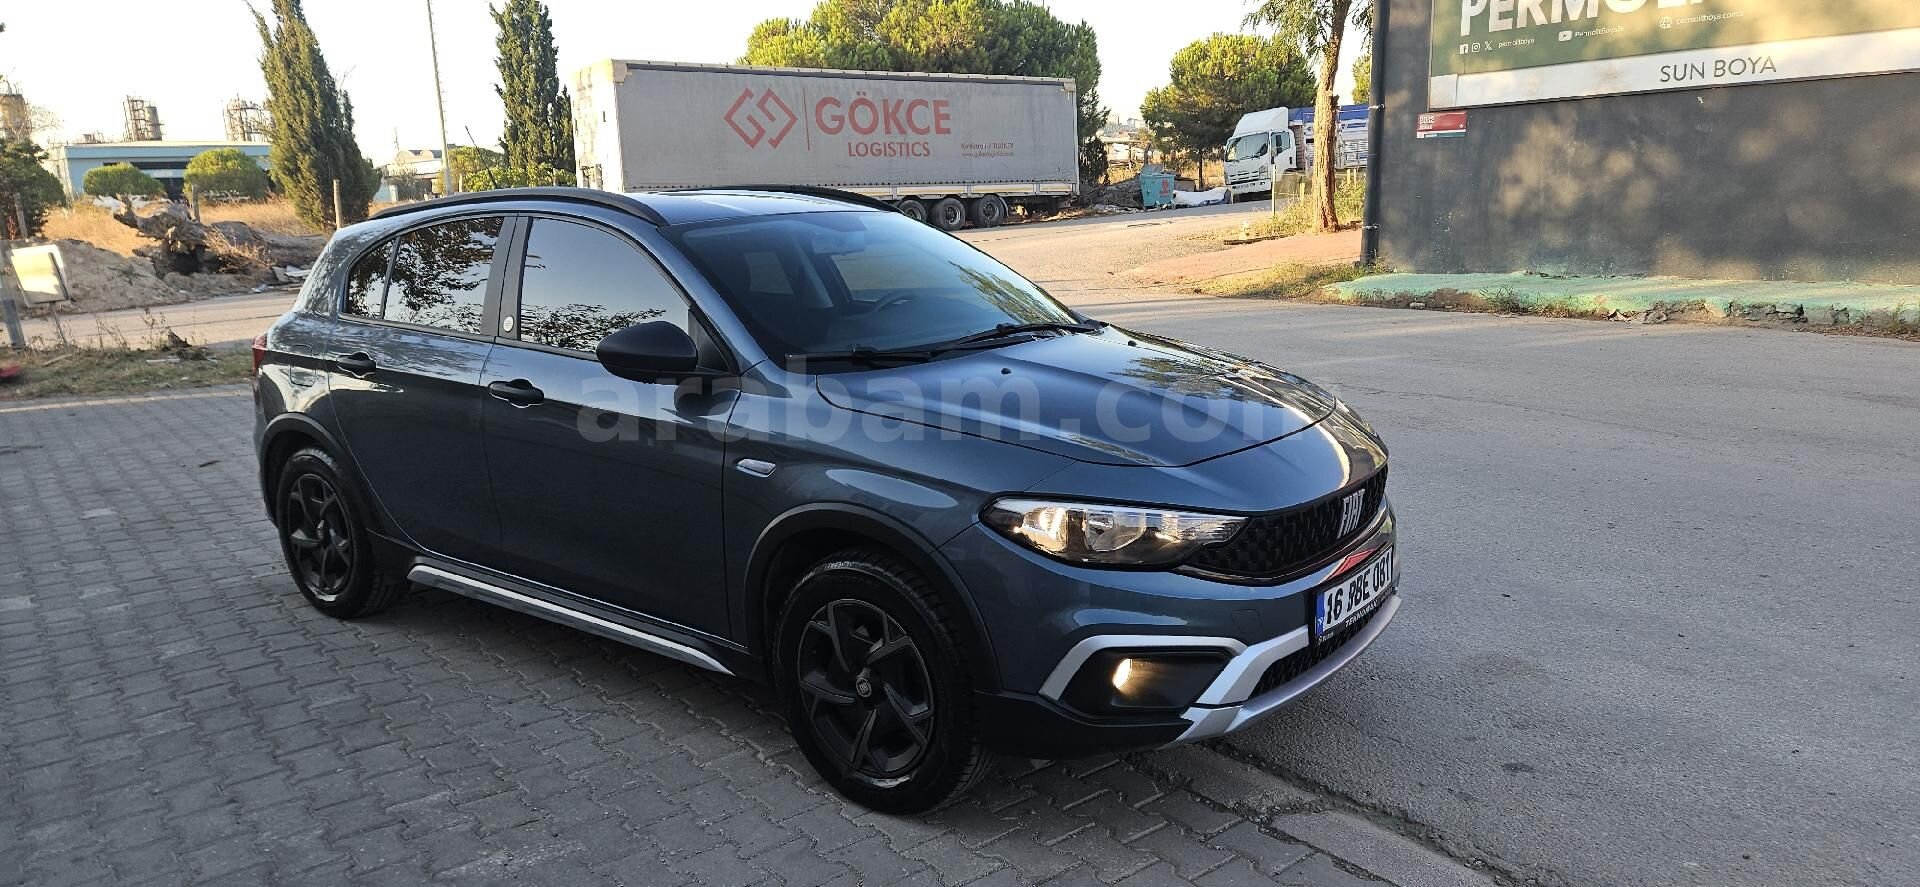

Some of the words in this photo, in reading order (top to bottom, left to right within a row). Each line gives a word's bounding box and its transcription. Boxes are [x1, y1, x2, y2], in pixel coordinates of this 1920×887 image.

[1660, 62, 1705, 82] SUN
[1713, 56, 1777, 78] BOYA
[847, 141, 931, 158] LOGISTICS
[1337, 488, 1365, 539] FIAT
[1326, 588, 1344, 625] 16
[1373, 551, 1390, 593] 081
